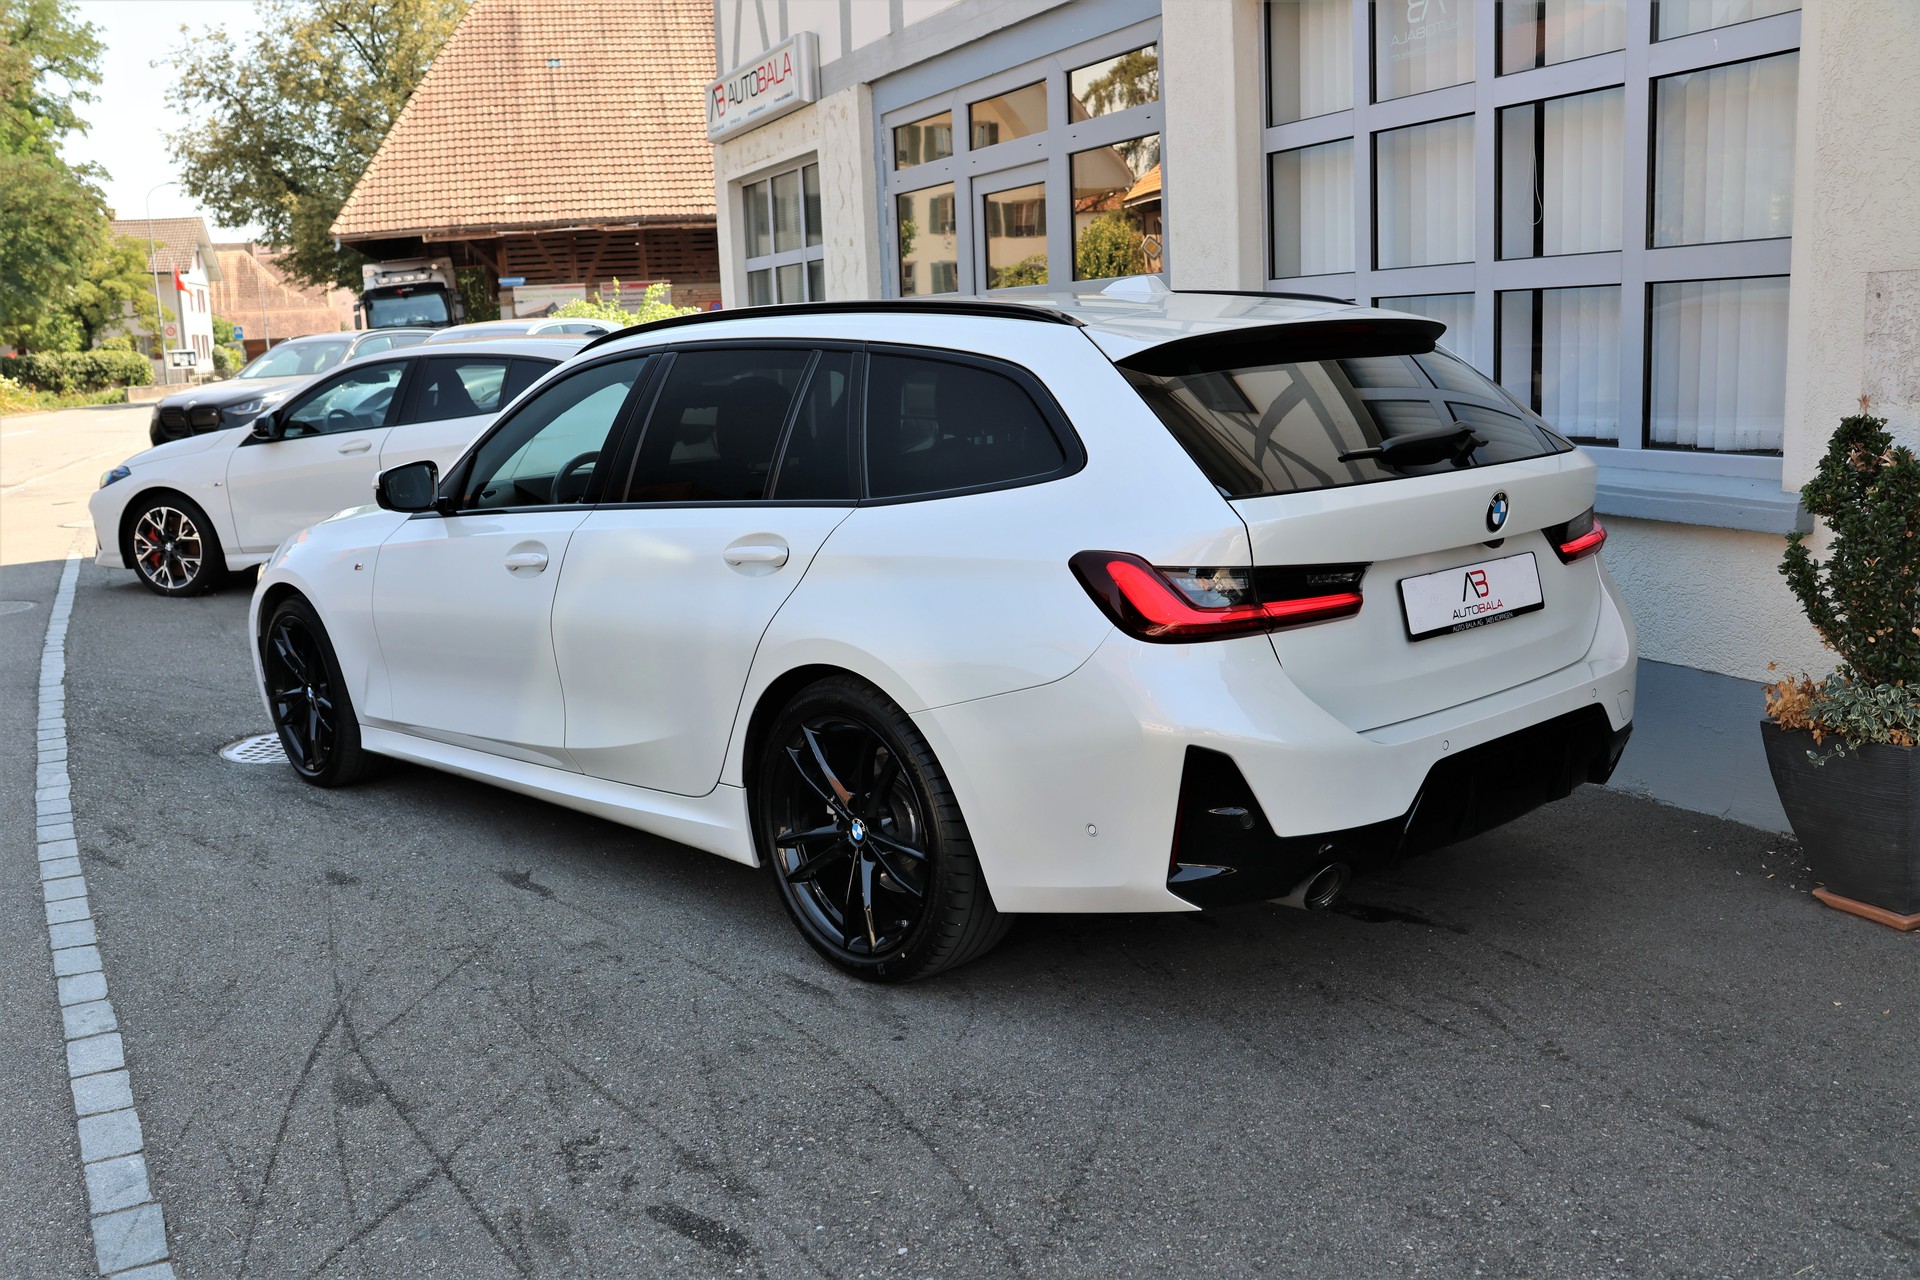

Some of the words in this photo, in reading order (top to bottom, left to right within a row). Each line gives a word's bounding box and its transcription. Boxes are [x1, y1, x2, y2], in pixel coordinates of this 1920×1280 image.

[710, 83, 726, 122] AB
[728, 52, 792, 109] AUTOBALA
[1463, 570, 1489, 602] AB
[1452, 599, 1503, 620] AUTOBALA
[1452, 624, 1465, 632] AUTO
